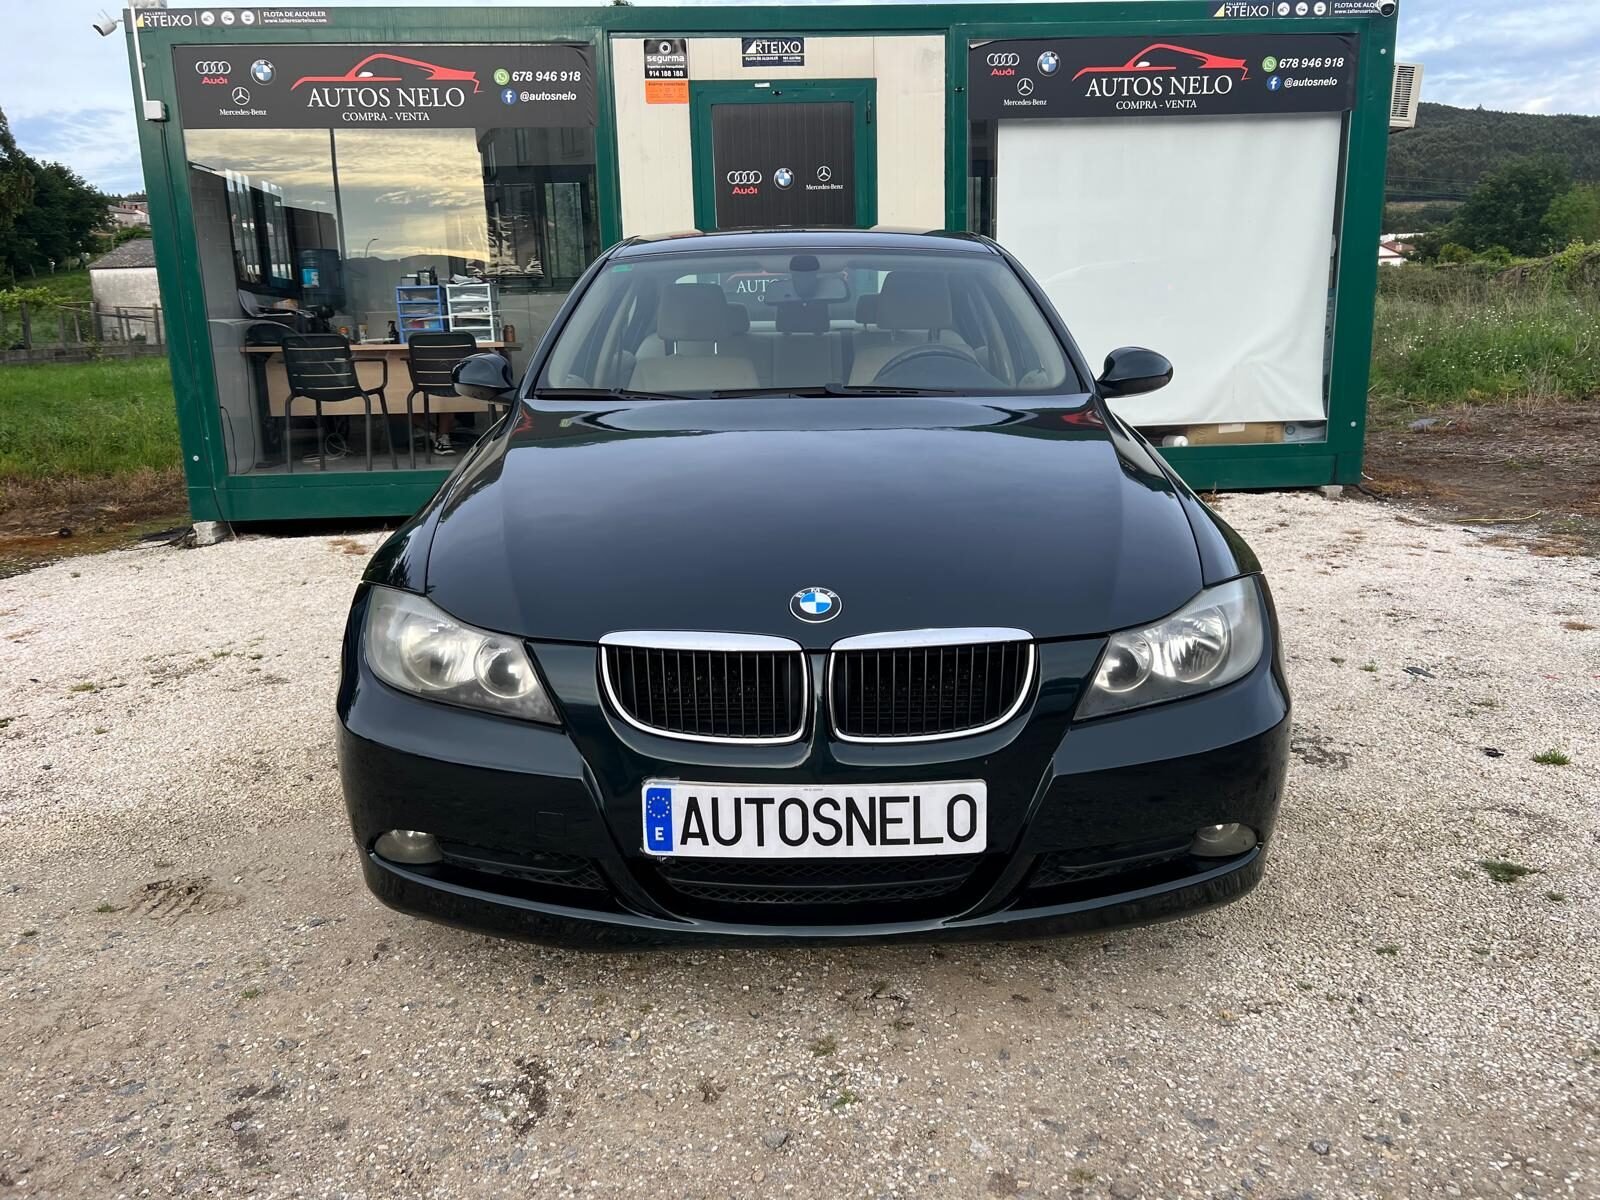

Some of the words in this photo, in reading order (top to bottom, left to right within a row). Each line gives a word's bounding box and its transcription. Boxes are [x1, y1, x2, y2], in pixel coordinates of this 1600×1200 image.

[646, 55, 685, 64] segurma
[1279, 58, 1299, 68] 678
[1301, 57, 1322, 68] 946
[1324, 57, 1344, 67] 918
[511, 71, 533, 82] 678
[535, 71, 558, 82] 946
[560, 71, 581, 82] 918
[991, 68, 1015, 76] Audi
[202, 76, 228, 84] Audi
[1284, 77, 1338, 88] @autosnelo
[1085, 76, 1163, 97] AUTOS
[1169, 75, 1233, 95] NELO
[307, 87, 391, 108] AUTOS
[396, 87, 465, 108] NELO
[519, 90, 577, 102] @autosnelo
[1003, 98, 1047, 106] Mercedes-Benz
[1115, 100, 1158, 110] COMPRA
[1165, 99, 1197, 109] VENTA
[219, 108, 267, 116] Mercedes-Benz
[342, 112, 387, 121] COMPRA
[394, 112, 430, 121] VENTA
[732, 186, 758, 194] Audi
[680, 793, 977, 847] AUTOSNELO
[654, 826, 664, 841] E
